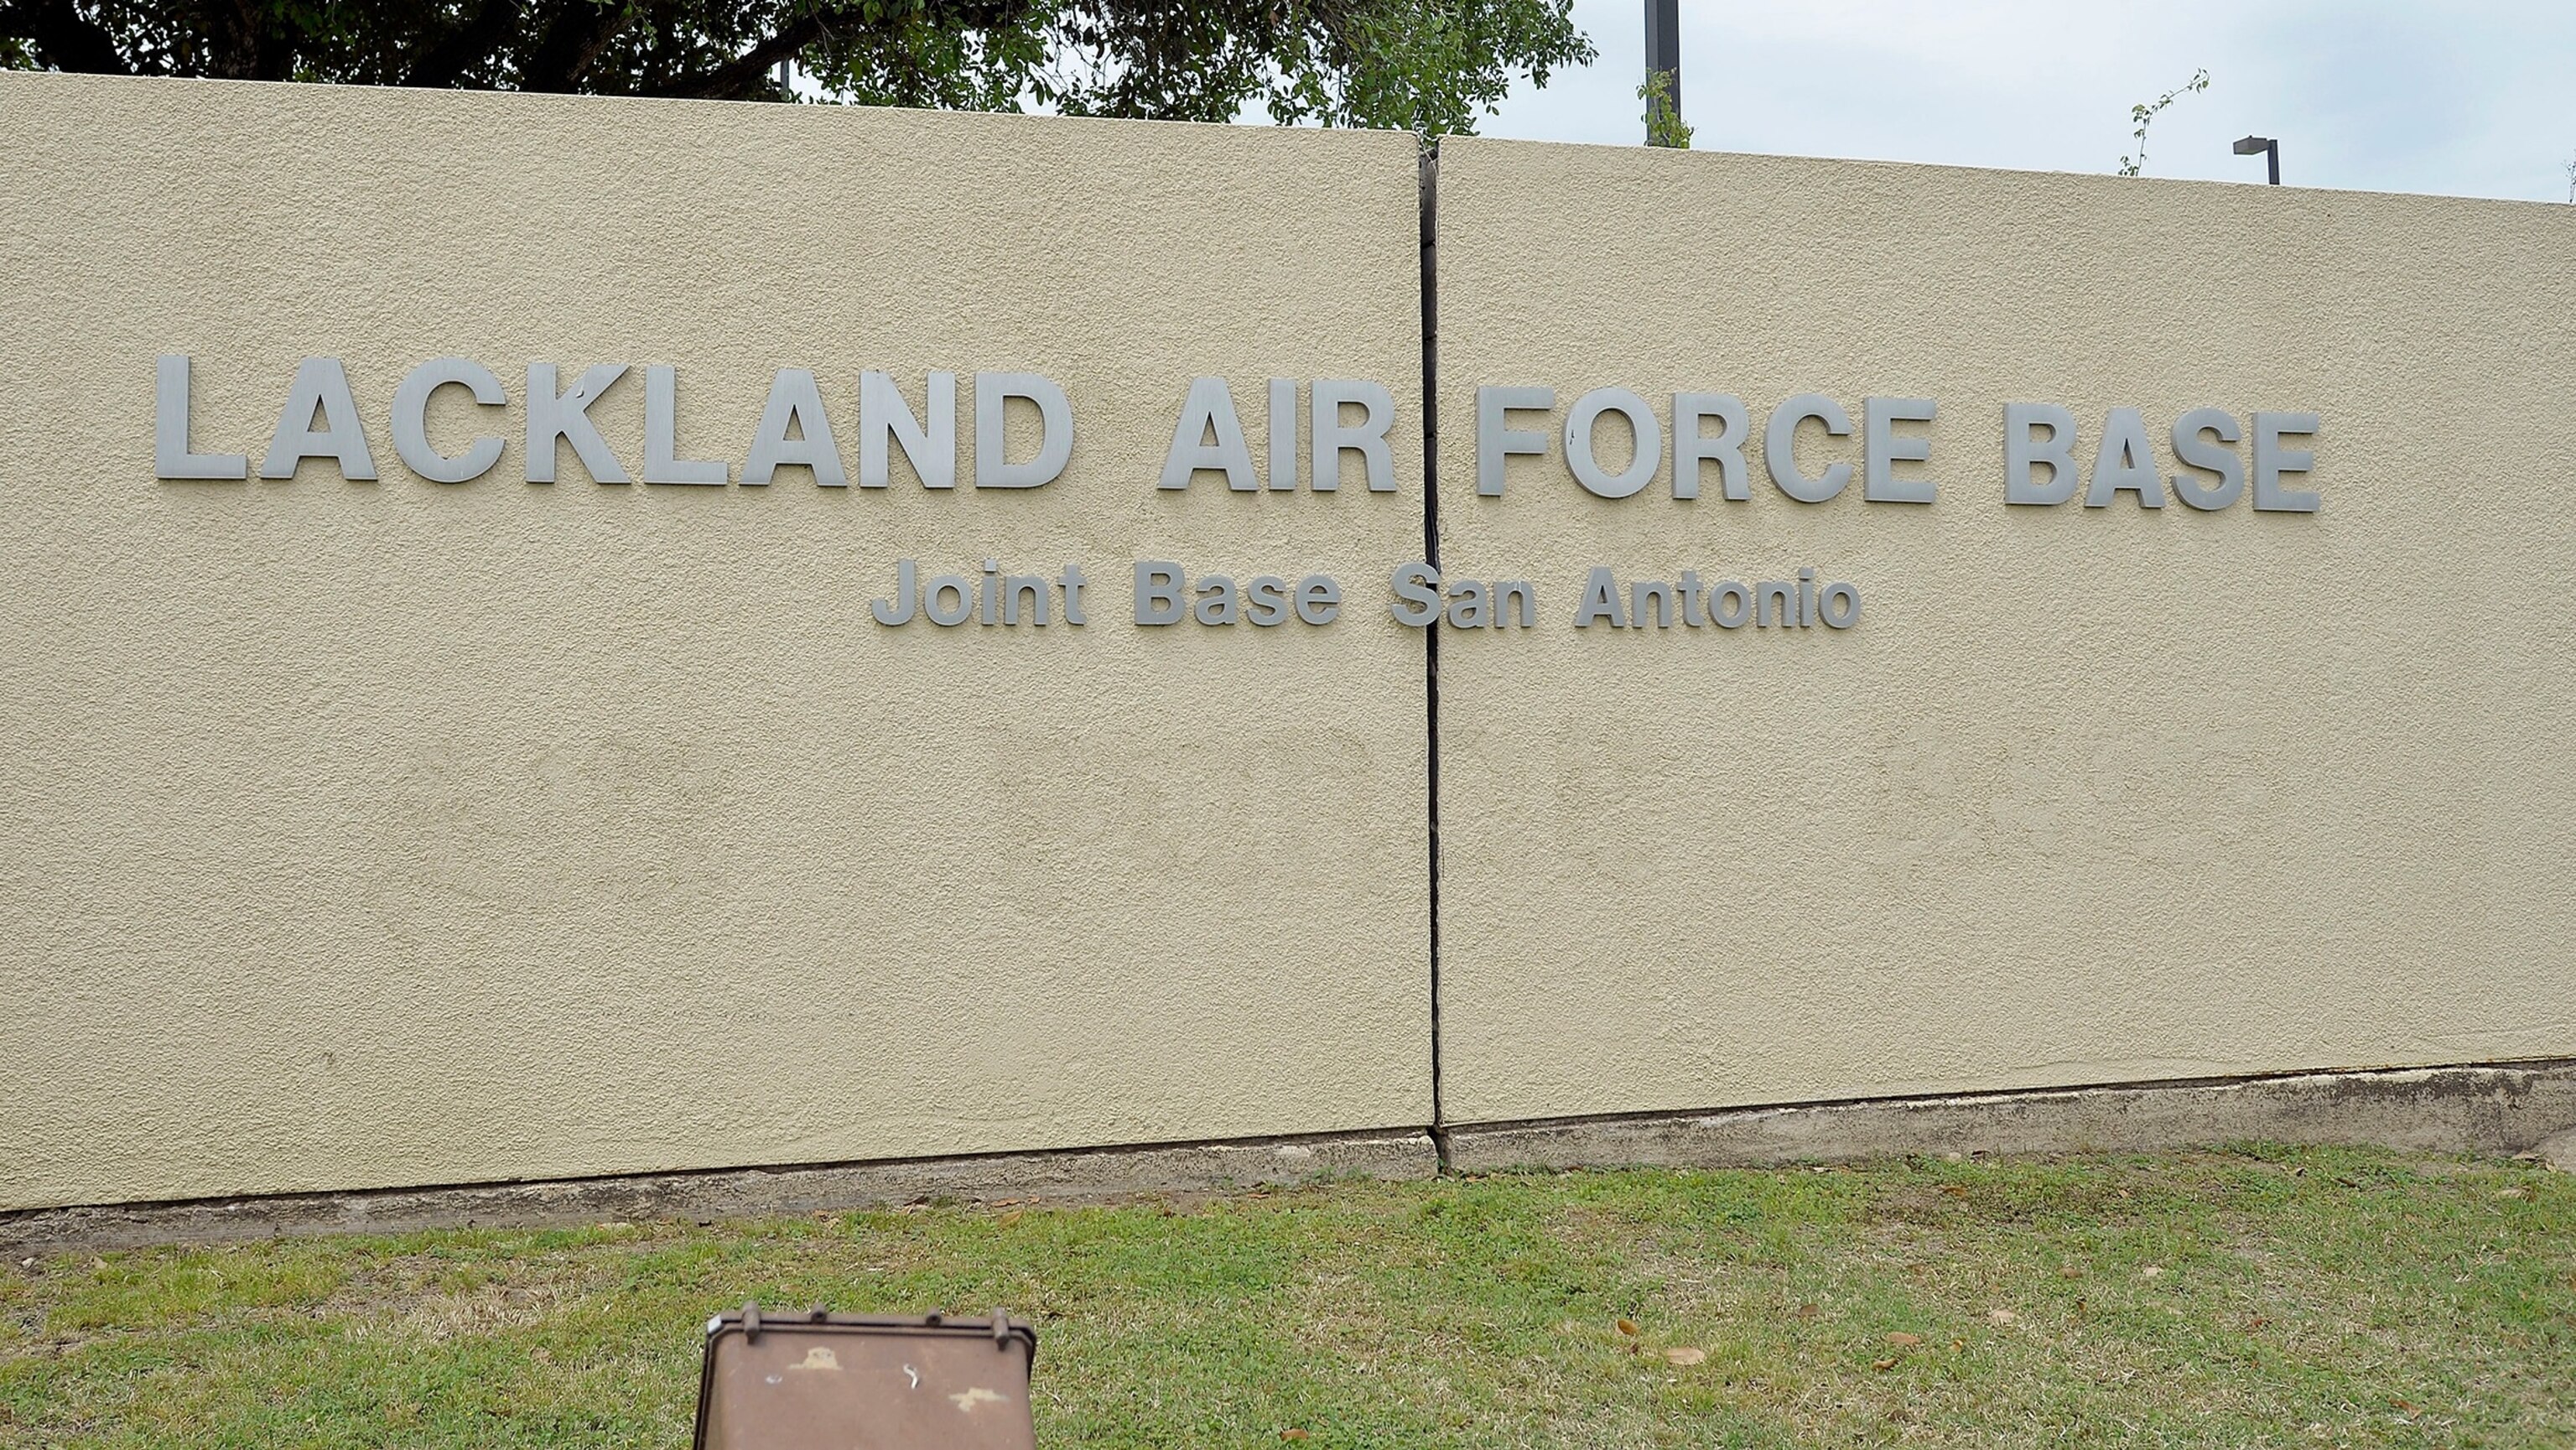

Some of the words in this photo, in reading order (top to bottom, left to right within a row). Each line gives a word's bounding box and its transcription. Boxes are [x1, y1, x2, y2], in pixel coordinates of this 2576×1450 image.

[154, 352, 1077, 490] LACKLAND
[1158, 375, 1399, 493] AIR
[1474, 383, 1939, 505] FORCE
[2002, 401, 2323, 514] BASE
[871, 557, 1088, 627] Joint
[1134, 559, 1343, 627] Base
[1389, 560, 1536, 629] San
[1574, 564, 1863, 629] Antonio
